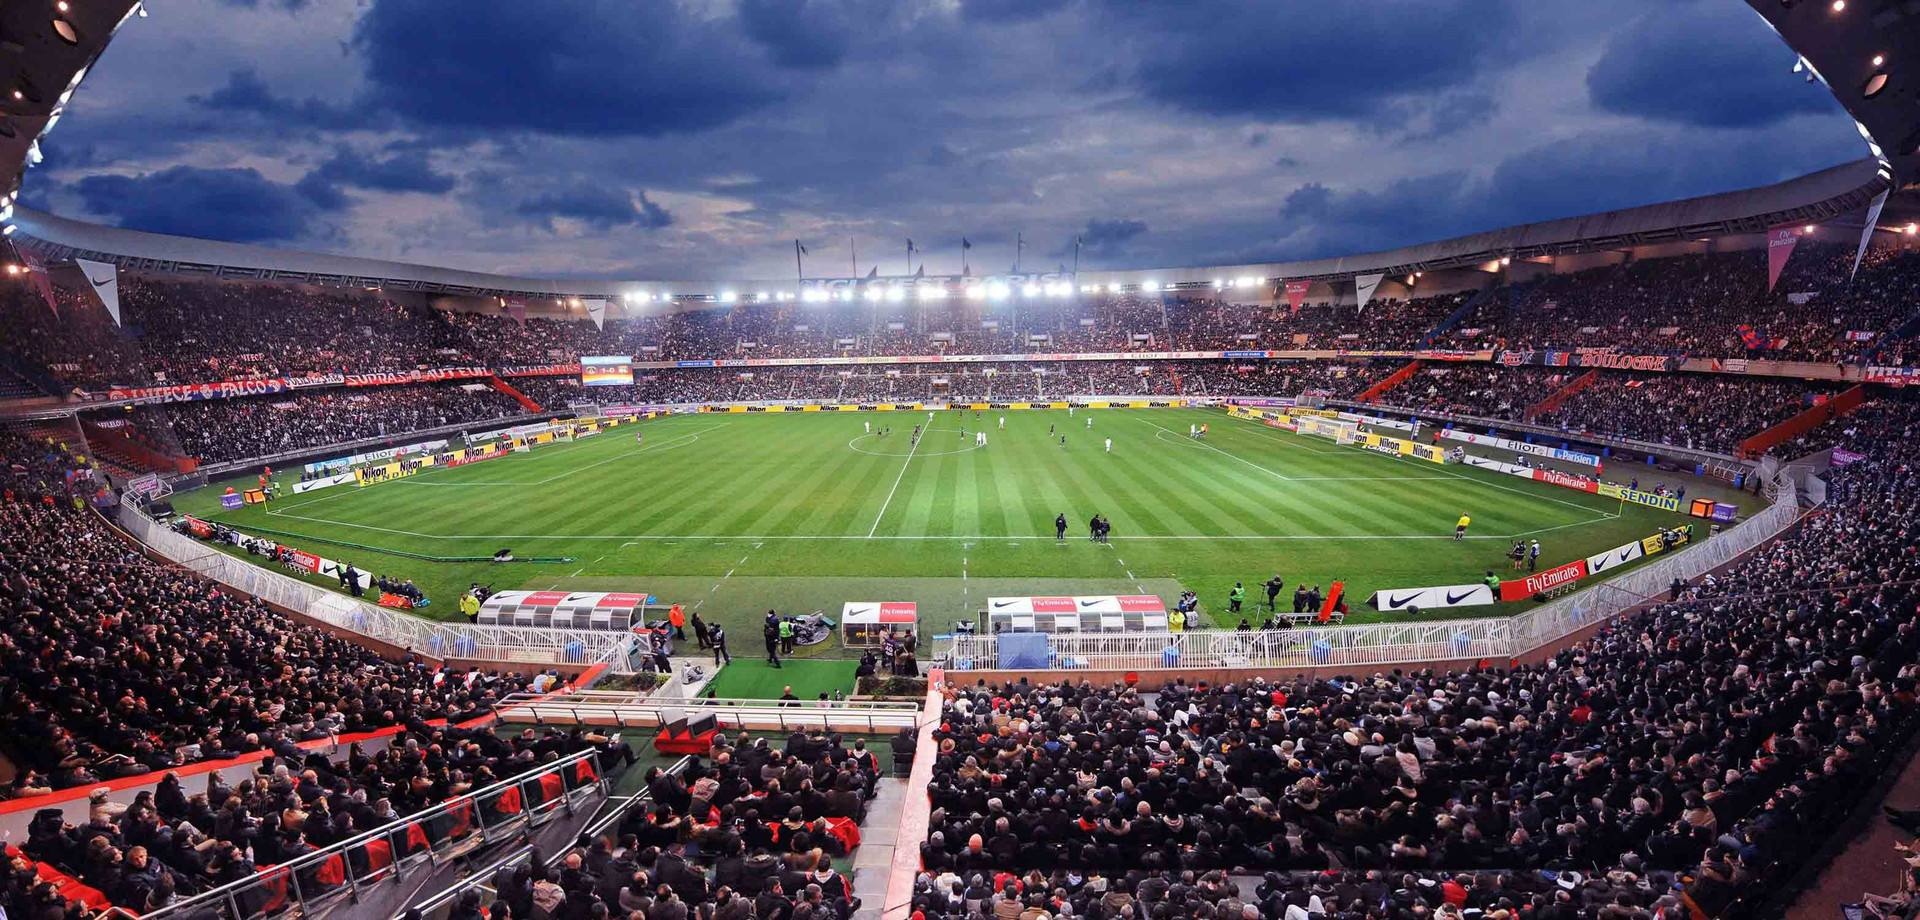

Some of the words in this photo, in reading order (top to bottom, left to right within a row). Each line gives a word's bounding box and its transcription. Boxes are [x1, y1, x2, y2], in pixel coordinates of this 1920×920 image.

[1770, 237, 1796, 247] Emirates
[346, 372, 406, 385] SUPRAS
[427, 367, 492, 379] AUTEUIL
[502, 364, 581, 376] AUTHENTIKS
[220, 381, 267, 398] FALCO
[495, 441, 514, 451] Nikon
[1379, 437, 1400, 451] Nikon
[1508, 441, 1538, 453] Elior
[364, 449, 393, 461] Elior
[464, 447, 484, 459] Nikon
[1413, 444, 1433, 459] Nikon
[1563, 451, 1591, 464] Parisien
[400, 459, 422, 471] Nikon
[434, 453, 454, 465] Nikon
[362, 466, 387, 480] Nikon
[1543, 472, 1556, 483] Fly
[1555, 475, 1587, 489] Emirates
[1620, 489, 1675, 510] SENDIN
[291, 551, 315, 568] mirates
[1526, 577, 1543, 593] Fly
[1542, 567, 1579, 588] Emirates
